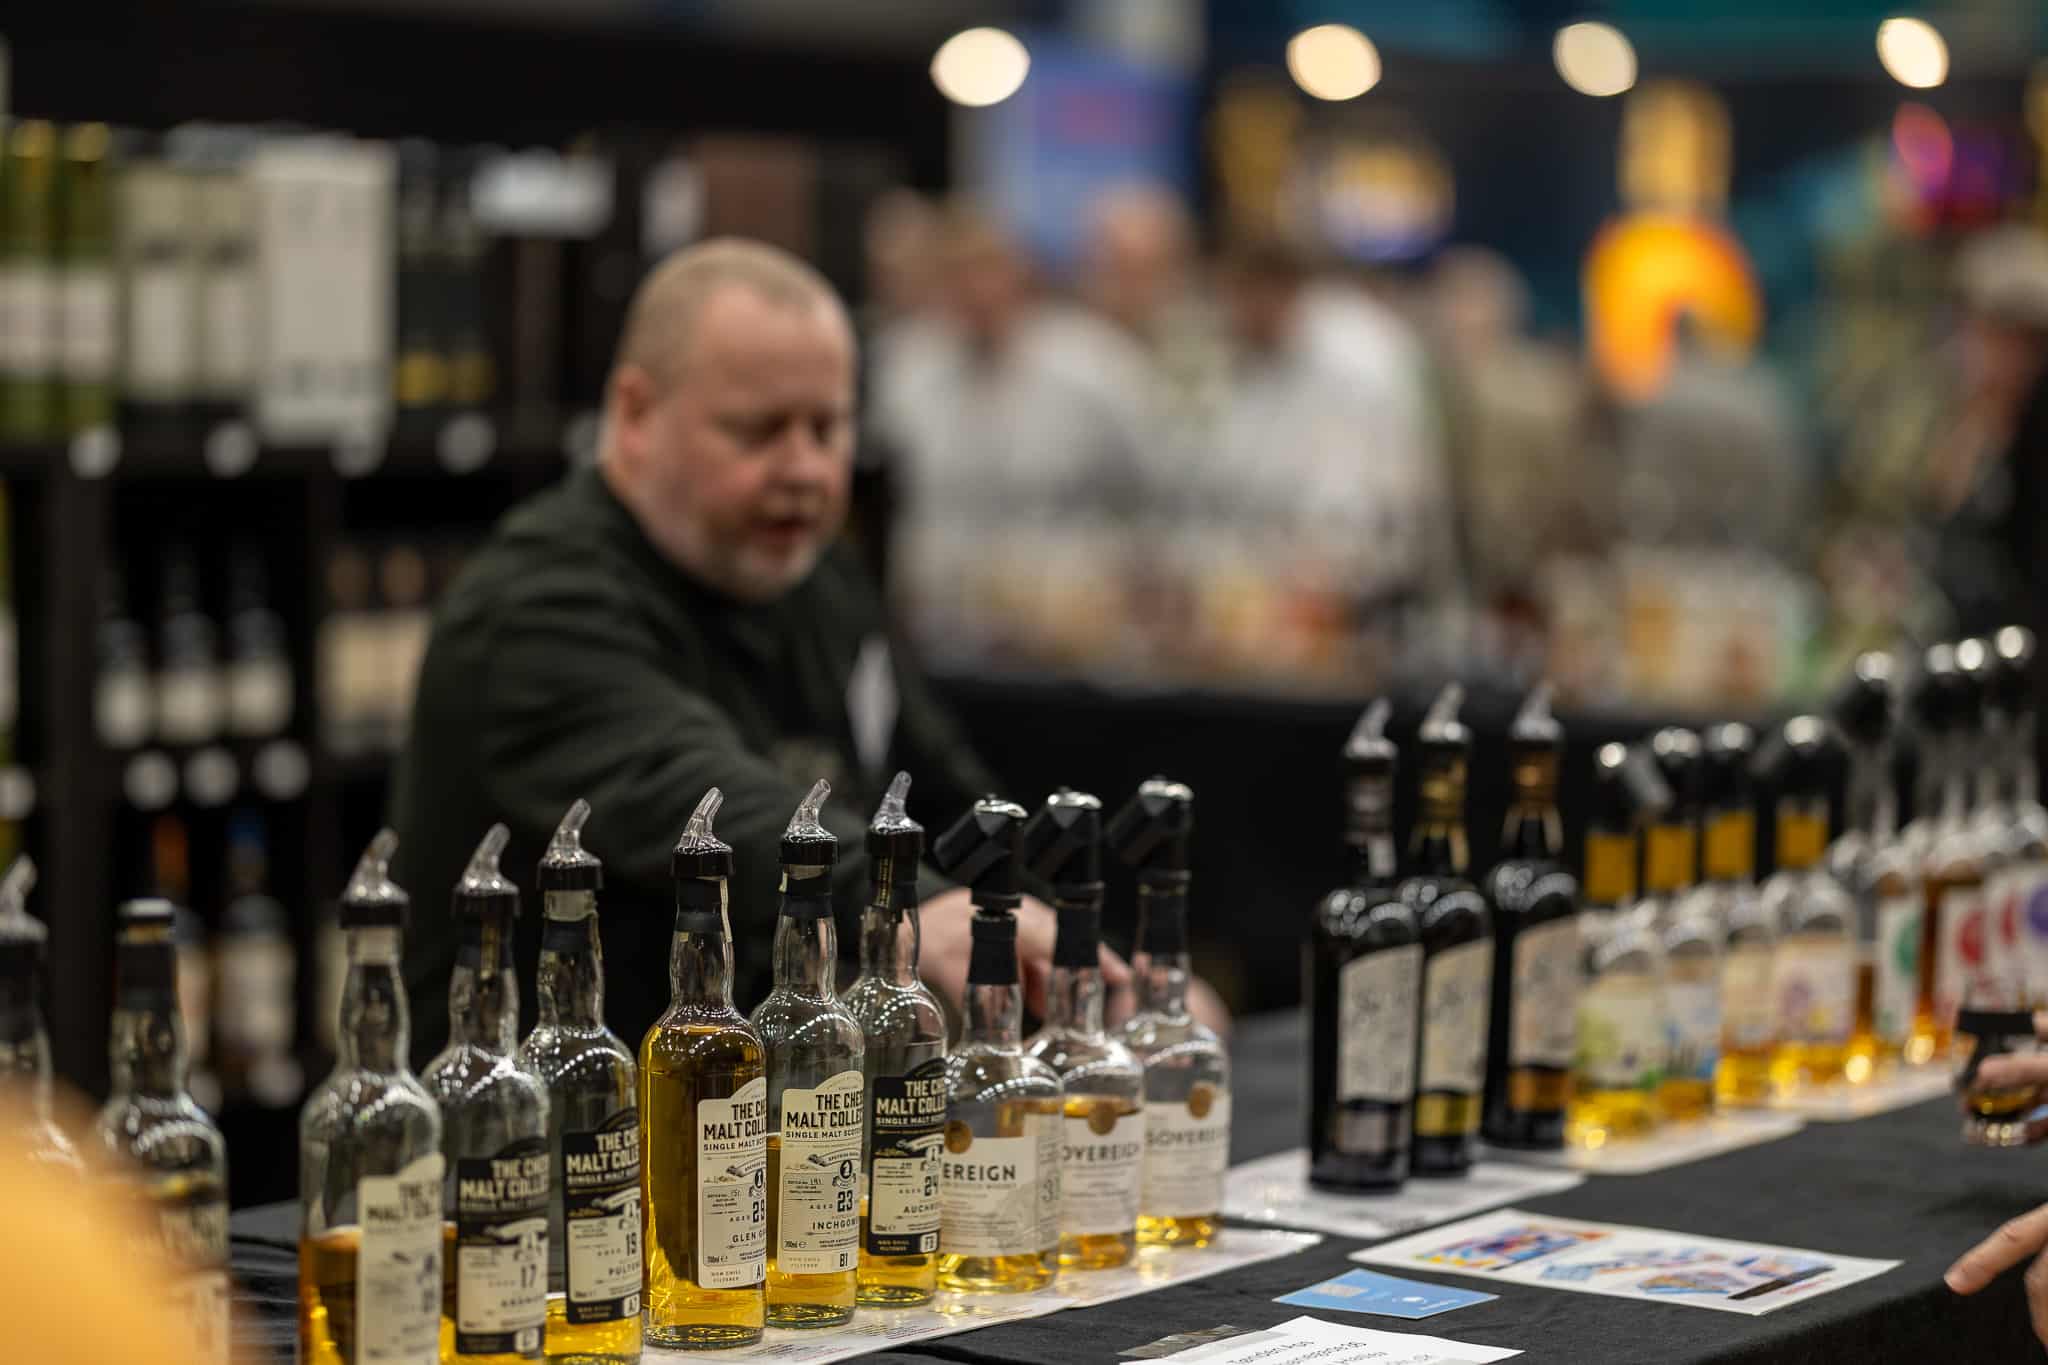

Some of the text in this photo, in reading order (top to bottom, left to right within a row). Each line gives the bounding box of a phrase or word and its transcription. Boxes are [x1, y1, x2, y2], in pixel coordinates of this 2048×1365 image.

[904, 1081, 929, 1097] THE
[816, 1092, 841, 1110] THE
[876, 1098, 915, 1115] MALT
[731, 1102, 753, 1121] THE
[787, 1111, 827, 1128] MALT
[703, 1122, 742, 1141] MALT
[785, 1130, 819, 1139] SINGLE
[821, 1130, 842, 1138] MALT
[595, 1132, 622, 1152] THE
[703, 1142, 736, 1152] SINGLE
[567, 1152, 609, 1174] MALT
[943, 1162, 1016, 1182] EREIGN
[461, 1179, 504, 1201] MALT
[837, 1189, 853, 1214] 23
[732, 1231, 756, 1243] GLEN
